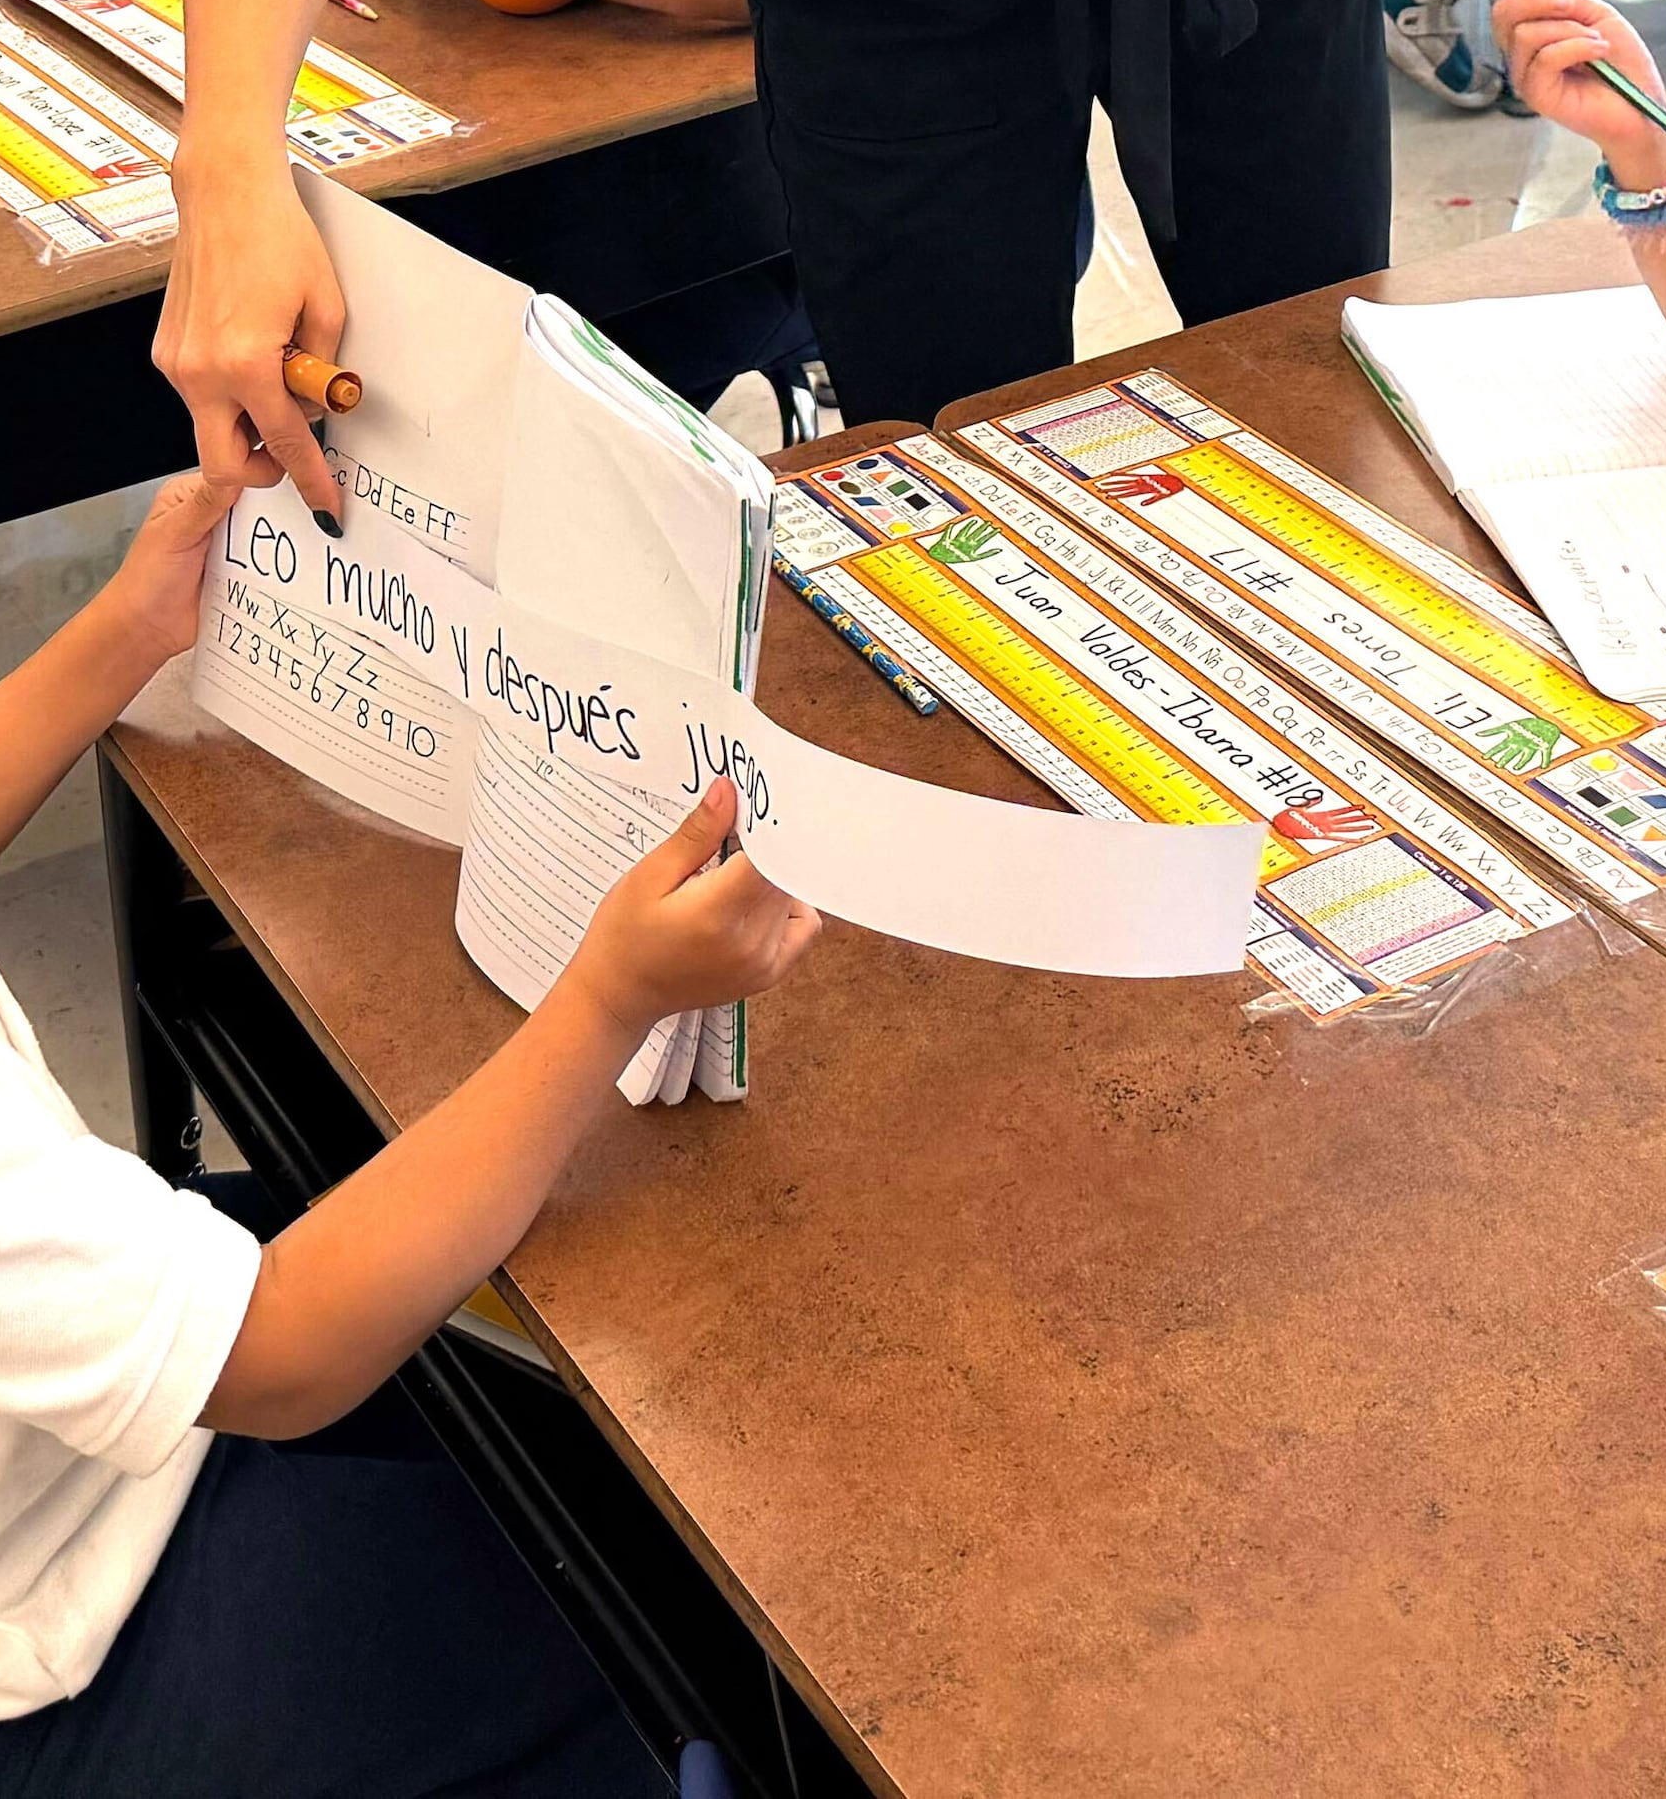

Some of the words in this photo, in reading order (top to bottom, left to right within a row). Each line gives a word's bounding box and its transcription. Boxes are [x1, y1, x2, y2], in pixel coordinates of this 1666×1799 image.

[354, 466, 382, 510] Dd
[389, 482, 416, 527] Ee
[994, 560, 1065, 621] Juan
[1208, 547, 1294, 594] #17
[227, 578, 261, 620] Ww
[268, 597, 300, 646] Xx
[309, 623, 336, 676] Yy
[345, 645, 380, 693] Zz
[1323, 611, 1418, 686] Torres
[224, 506, 298, 587] Leo
[324, 544, 438, 658] mucho
[451, 626, 472, 699] y
[485, 627, 642, 765] después
[679, 701, 779, 833] juego.
[1433, 691, 1493, 732] Eli
